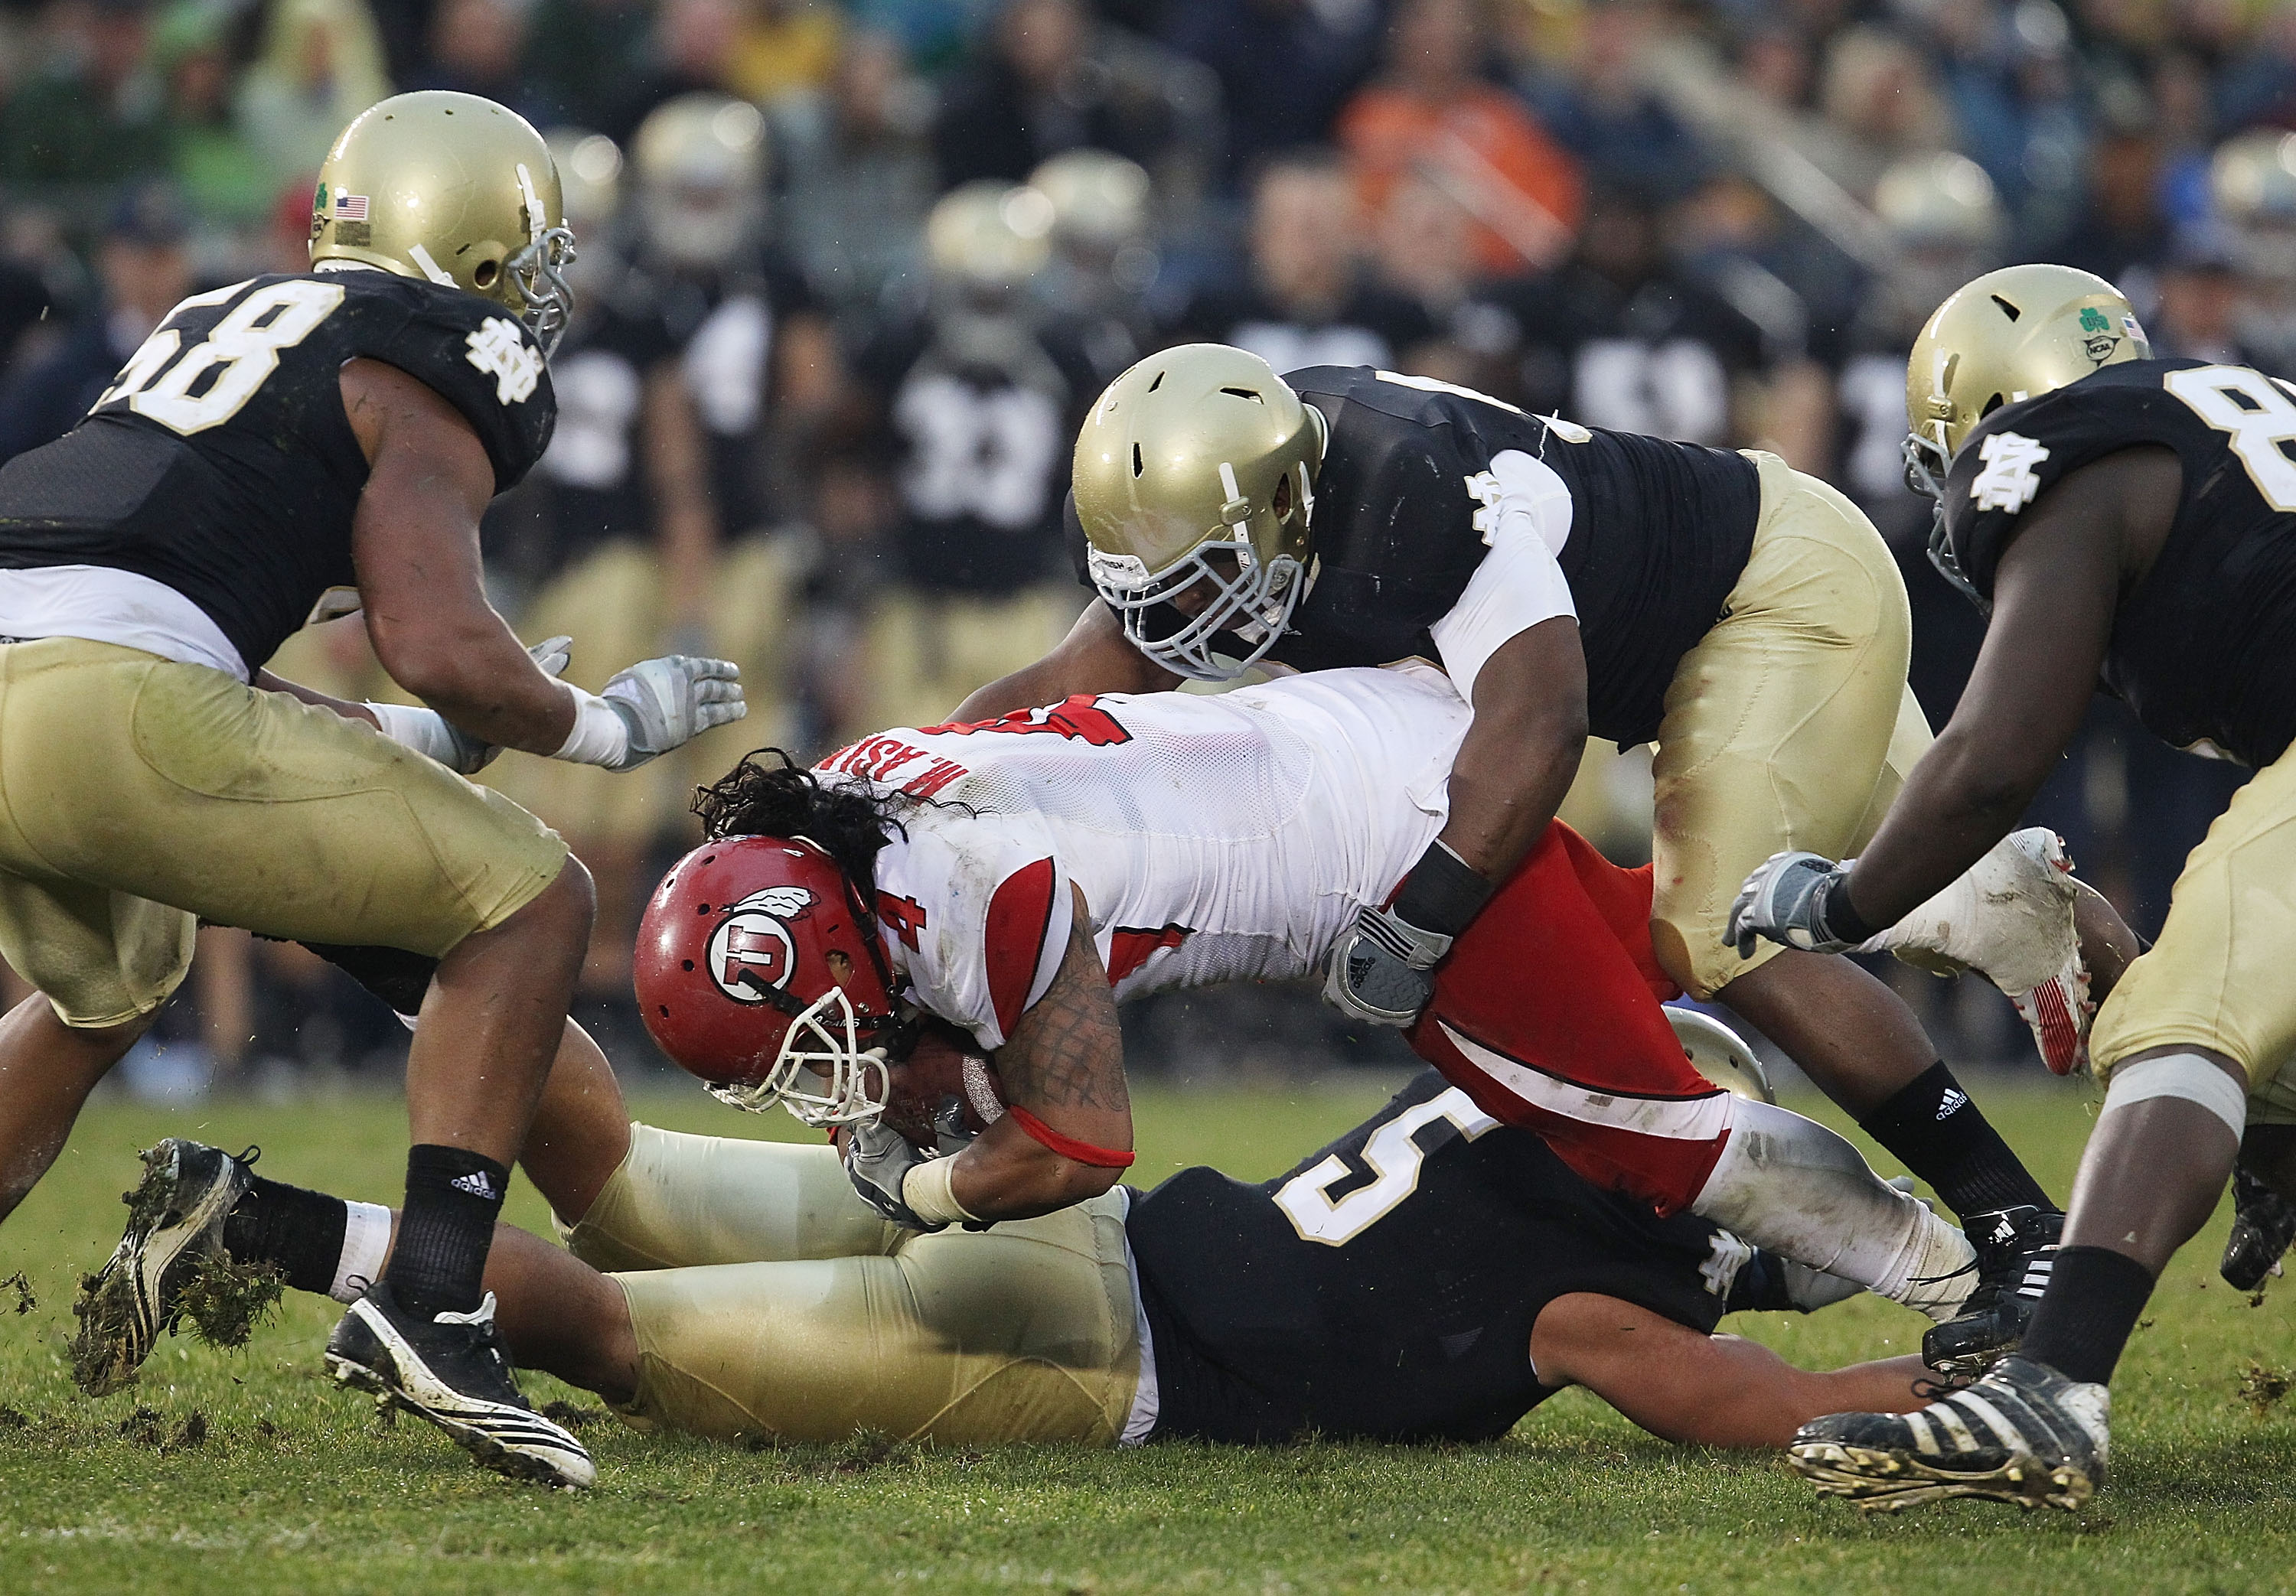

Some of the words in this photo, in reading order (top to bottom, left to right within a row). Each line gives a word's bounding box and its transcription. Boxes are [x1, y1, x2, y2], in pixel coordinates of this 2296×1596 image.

[88, 278, 345, 437] 58
[2089, 343, 2111, 354] NCAA
[2163, 363, 2296, 513] 8
[1353, 956, 1376, 989] adidas
[1936, 1091, 1968, 1120] adidas
[1271, 1085, 1505, 1248] 5
[450, 1178, 497, 1200] adidas
